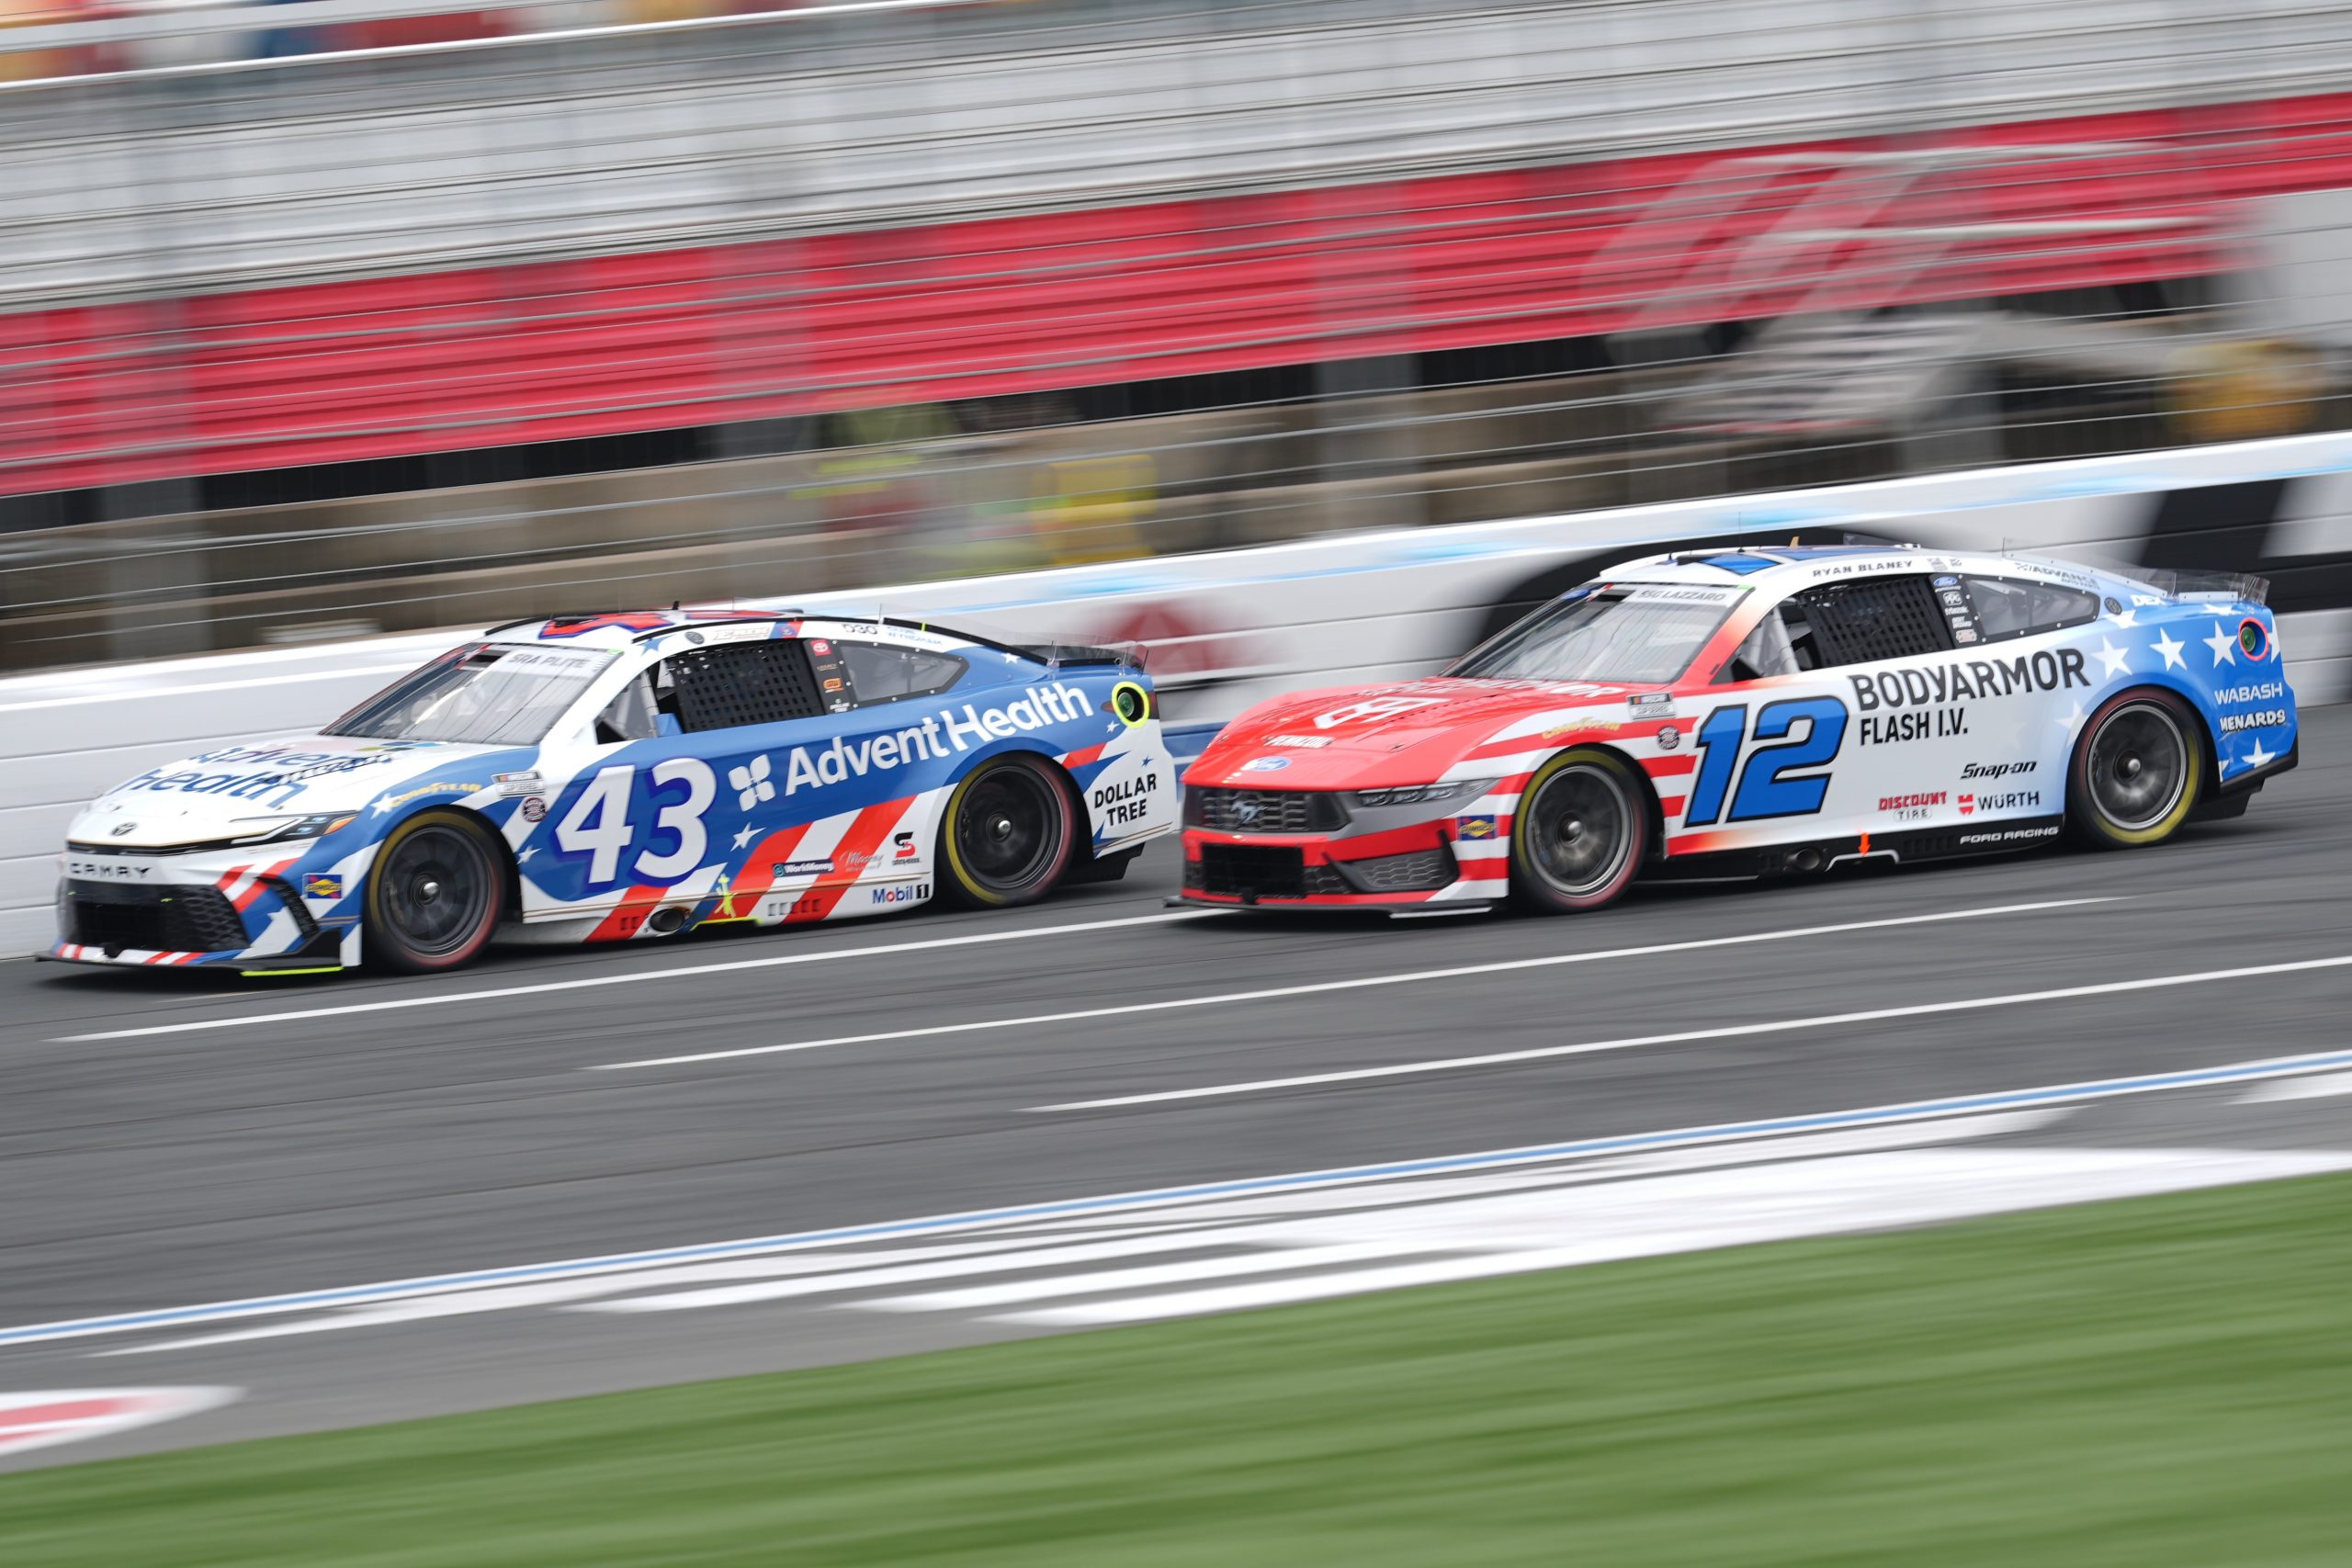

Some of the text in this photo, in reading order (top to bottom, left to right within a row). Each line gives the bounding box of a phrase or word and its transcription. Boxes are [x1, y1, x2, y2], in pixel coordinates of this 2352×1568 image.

[1813, 560, 1913, 577] RYAN BLANEY
[1848, 649, 2091, 711] BODYARMOR
[2214, 682, 2283, 705] WABASH
[1860, 706, 1969, 746] FLASH I.V.
[2219, 708, 2287, 733] MENARDS
[1683, 694, 1849, 829] 12
[1960, 761, 2038, 780] Snap-on
[1094, 773, 1158, 809] DOLLAR
[1878, 791, 1948, 812] DISCOUNT
[1978, 791, 2041, 811] WÜRTH
[552, 757, 719, 886] 43
[1106, 798, 1148, 827] TREE
[1897, 807, 1929, 821] TIRE
[1960, 827, 2060, 845] FORD RACING
[873, 885, 913, 905] Mobil
